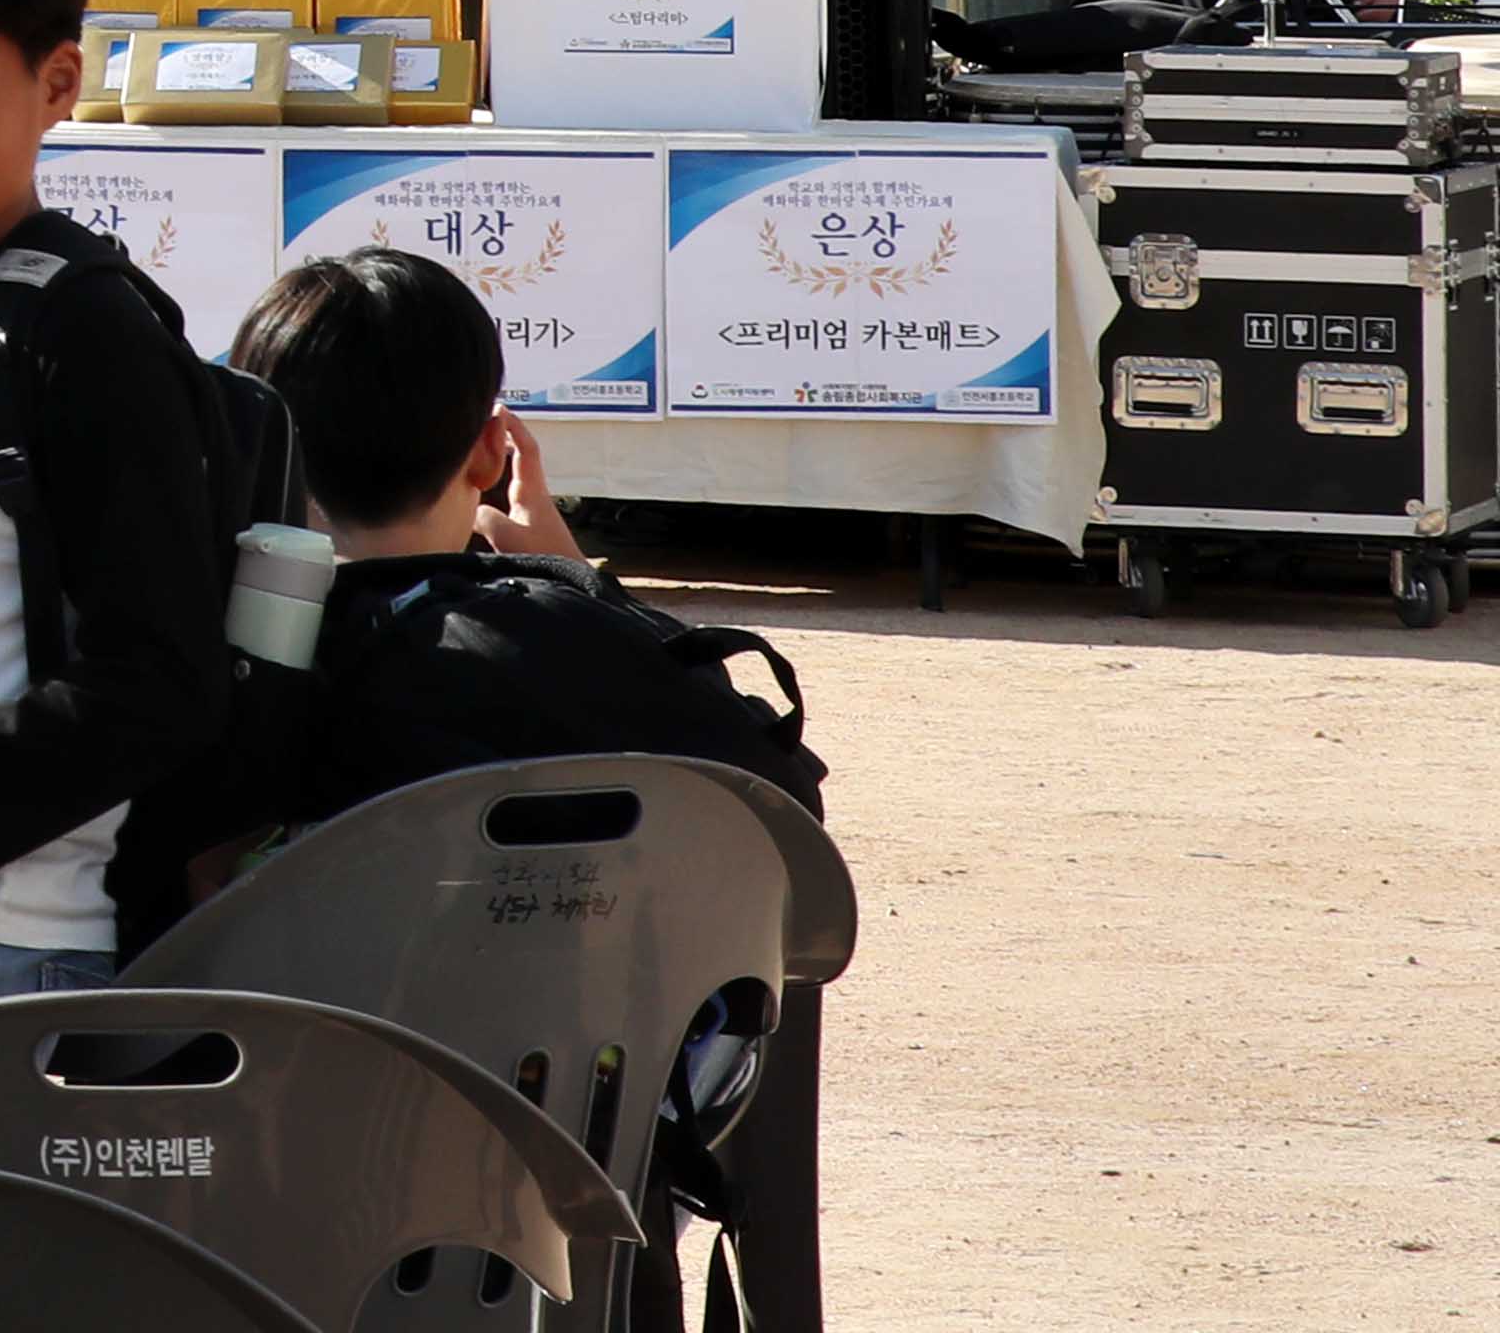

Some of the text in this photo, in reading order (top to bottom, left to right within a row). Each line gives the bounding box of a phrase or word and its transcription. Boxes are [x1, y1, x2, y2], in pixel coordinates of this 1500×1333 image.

[425, 210, 514, 257] 대상
[811, 211, 906, 259] 은상
[496, 317, 575, 349] 리기>
[718, 318, 1001, 351] <프리미엄 카본매트>
[40, 1135, 216, 1178] (주)인천렌탈
